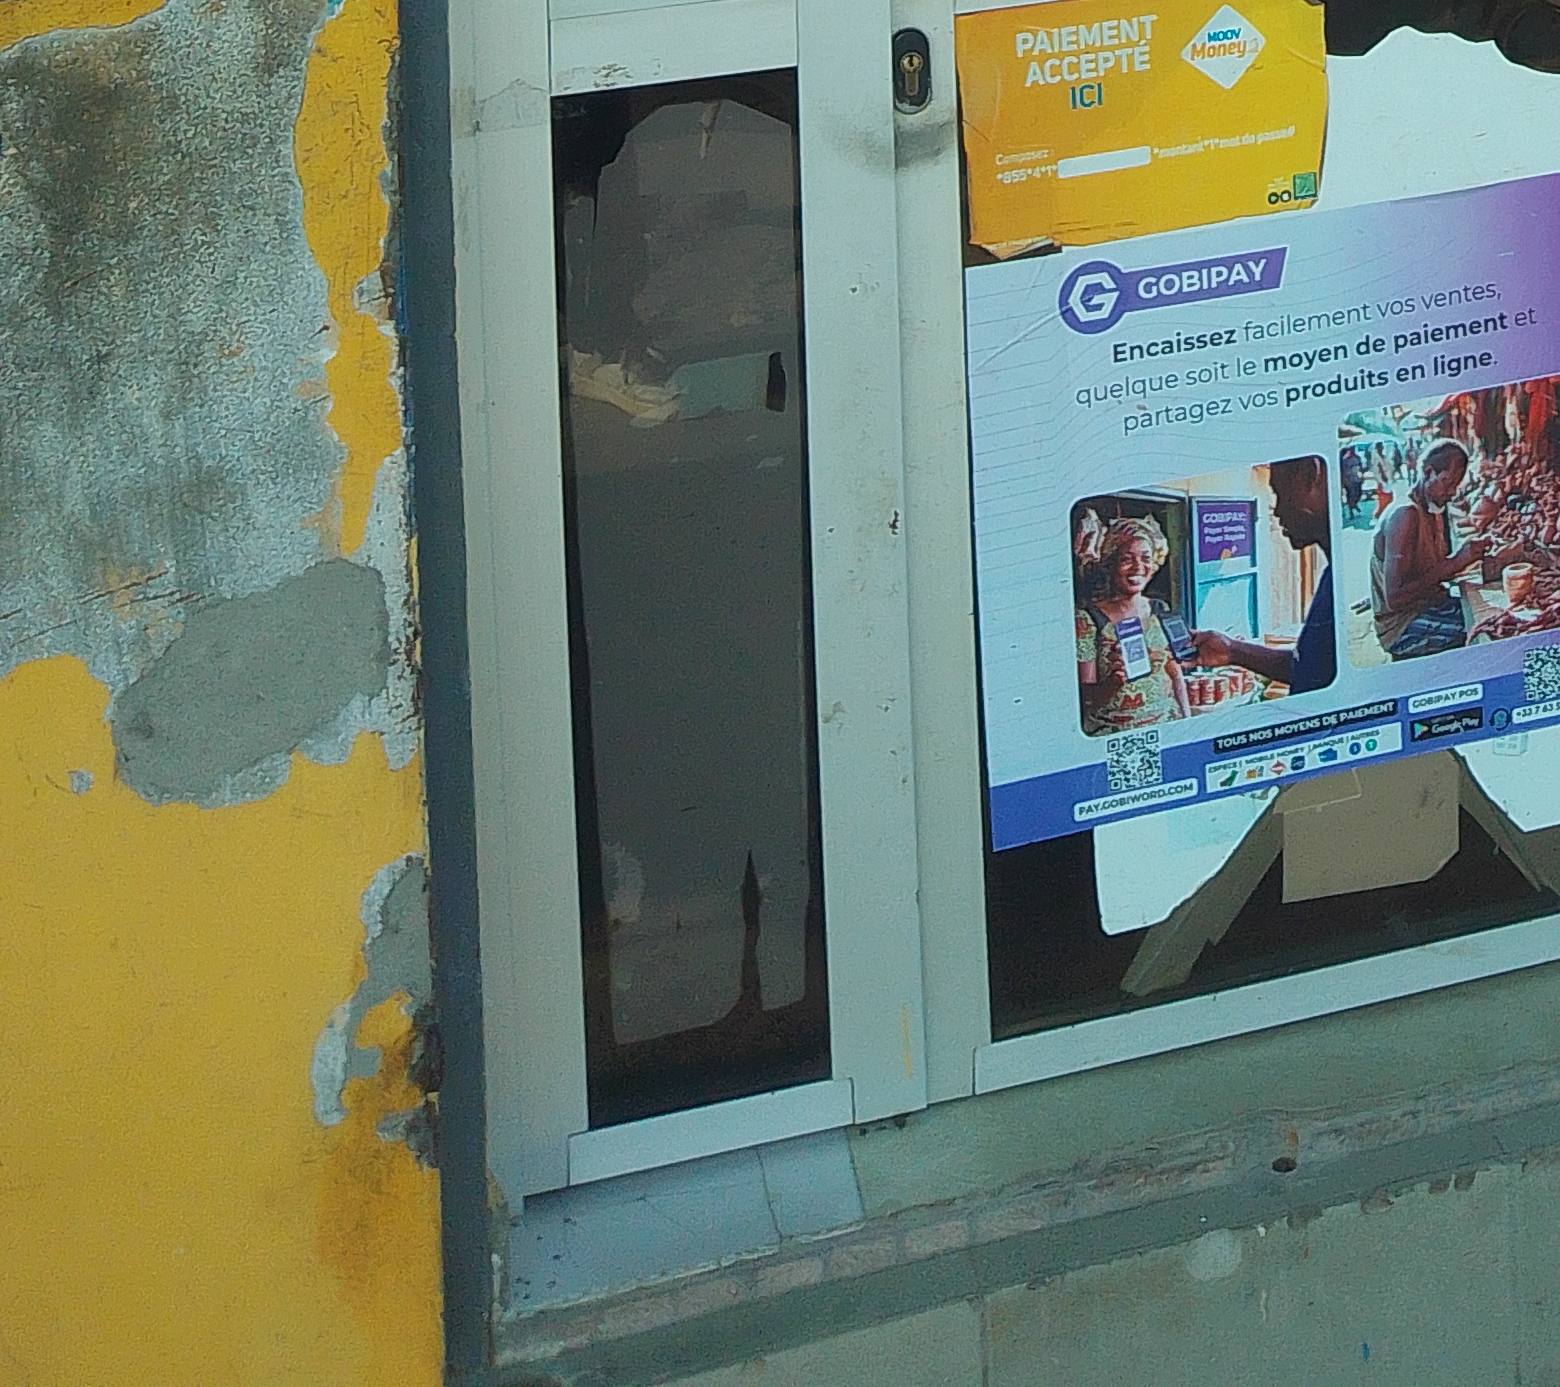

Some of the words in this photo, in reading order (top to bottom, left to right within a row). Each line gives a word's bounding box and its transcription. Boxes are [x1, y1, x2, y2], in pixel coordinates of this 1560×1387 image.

[1015, 15, 1157, 57] PAIEMENT
[1189, 38, 1247, 61] Money
[1207, 28, 1241, 43] MOOV
[1025, 41, 1151, 87] ACCEPTÉ
[1070, 82, 1103, 109] ICI
[1136, 258, 1268, 300] GOBIPAY
[1112, 326, 1237, 364] Encaissez
[1243, 302, 1371, 343] facilement
[1376, 296, 1416, 318] vos
[1421, 280, 1502, 312] ventes,
[1074, 371, 1179, 408] quelque
[1185, 361, 1230, 388] soit
[1234, 358, 1257, 378] le
[1263, 343, 1349, 381] moyen
[1355, 334, 1386, 357] de
[1392, 312, 1508, 355] paiement
[1514, 305, 1538, 327] et
[1122, 398, 1234, 437] partagez
[1240, 389, 1279, 410] vos
[1285, 366, 1389, 407] produits
[1395, 363, 1427, 384] en
[1432, 348, 1498, 379] ligne.
[1215, 735, 1246, 749] TOUS
[1249, 729, 1272, 741] NOS
[1275, 720, 1320, 738] MOYENS
[1322, 715, 1337, 726] DE
[1340, 701, 1395, 722] PAIEMENT
